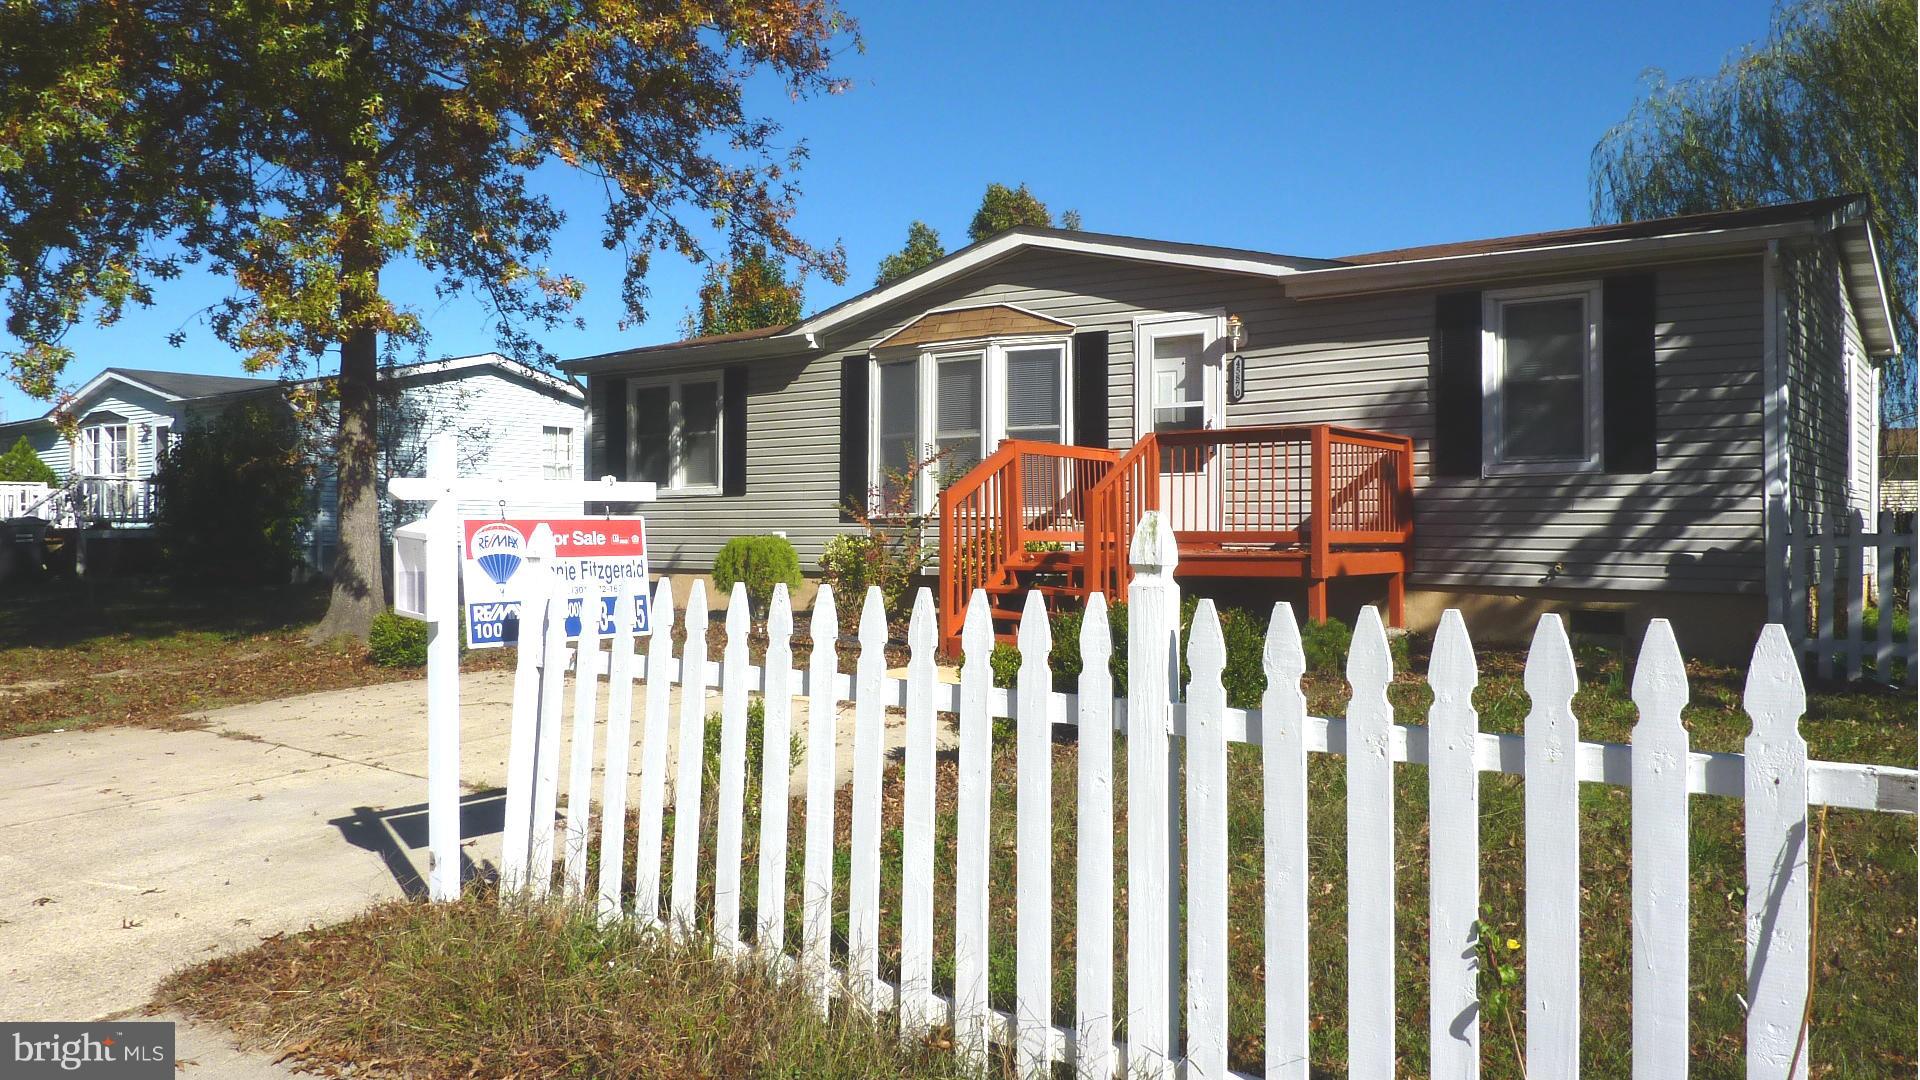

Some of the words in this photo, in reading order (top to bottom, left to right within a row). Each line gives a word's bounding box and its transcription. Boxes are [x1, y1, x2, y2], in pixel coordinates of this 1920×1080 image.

[478, 533, 519, 551] RE/MAX
[552, 532, 570, 546] or
[571, 529, 607, 546] Sale
[551, 560, 577, 581] nie
[580, 559, 645, 584] Fitzgerald
[473, 621, 503, 639] 100
